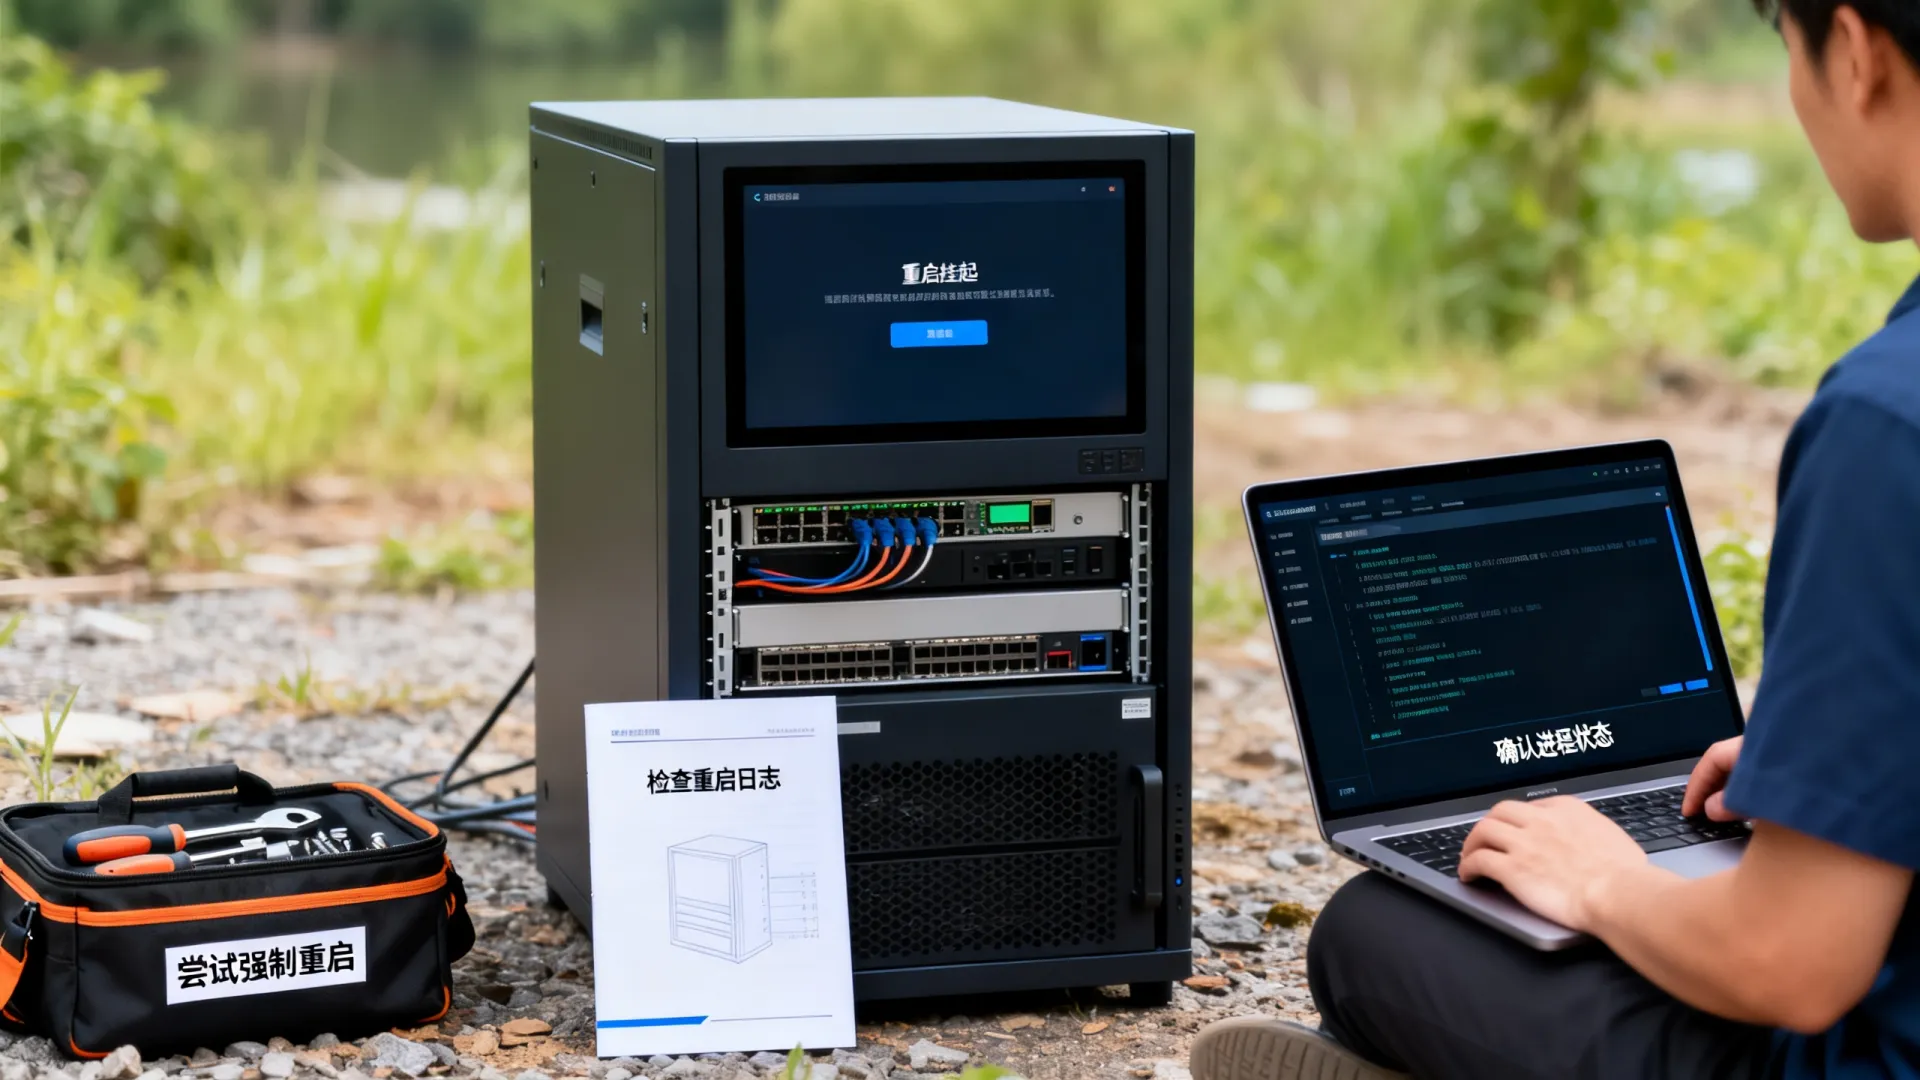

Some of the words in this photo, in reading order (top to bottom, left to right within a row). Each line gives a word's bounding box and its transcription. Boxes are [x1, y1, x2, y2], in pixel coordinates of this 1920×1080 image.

[902, 261, 978, 285] 重启挂起
[1493, 721, 1615, 765] 确认进程状态
[647, 765, 781, 794] 检查重启日志
[177, 940, 355, 989] 尝试强制重启
